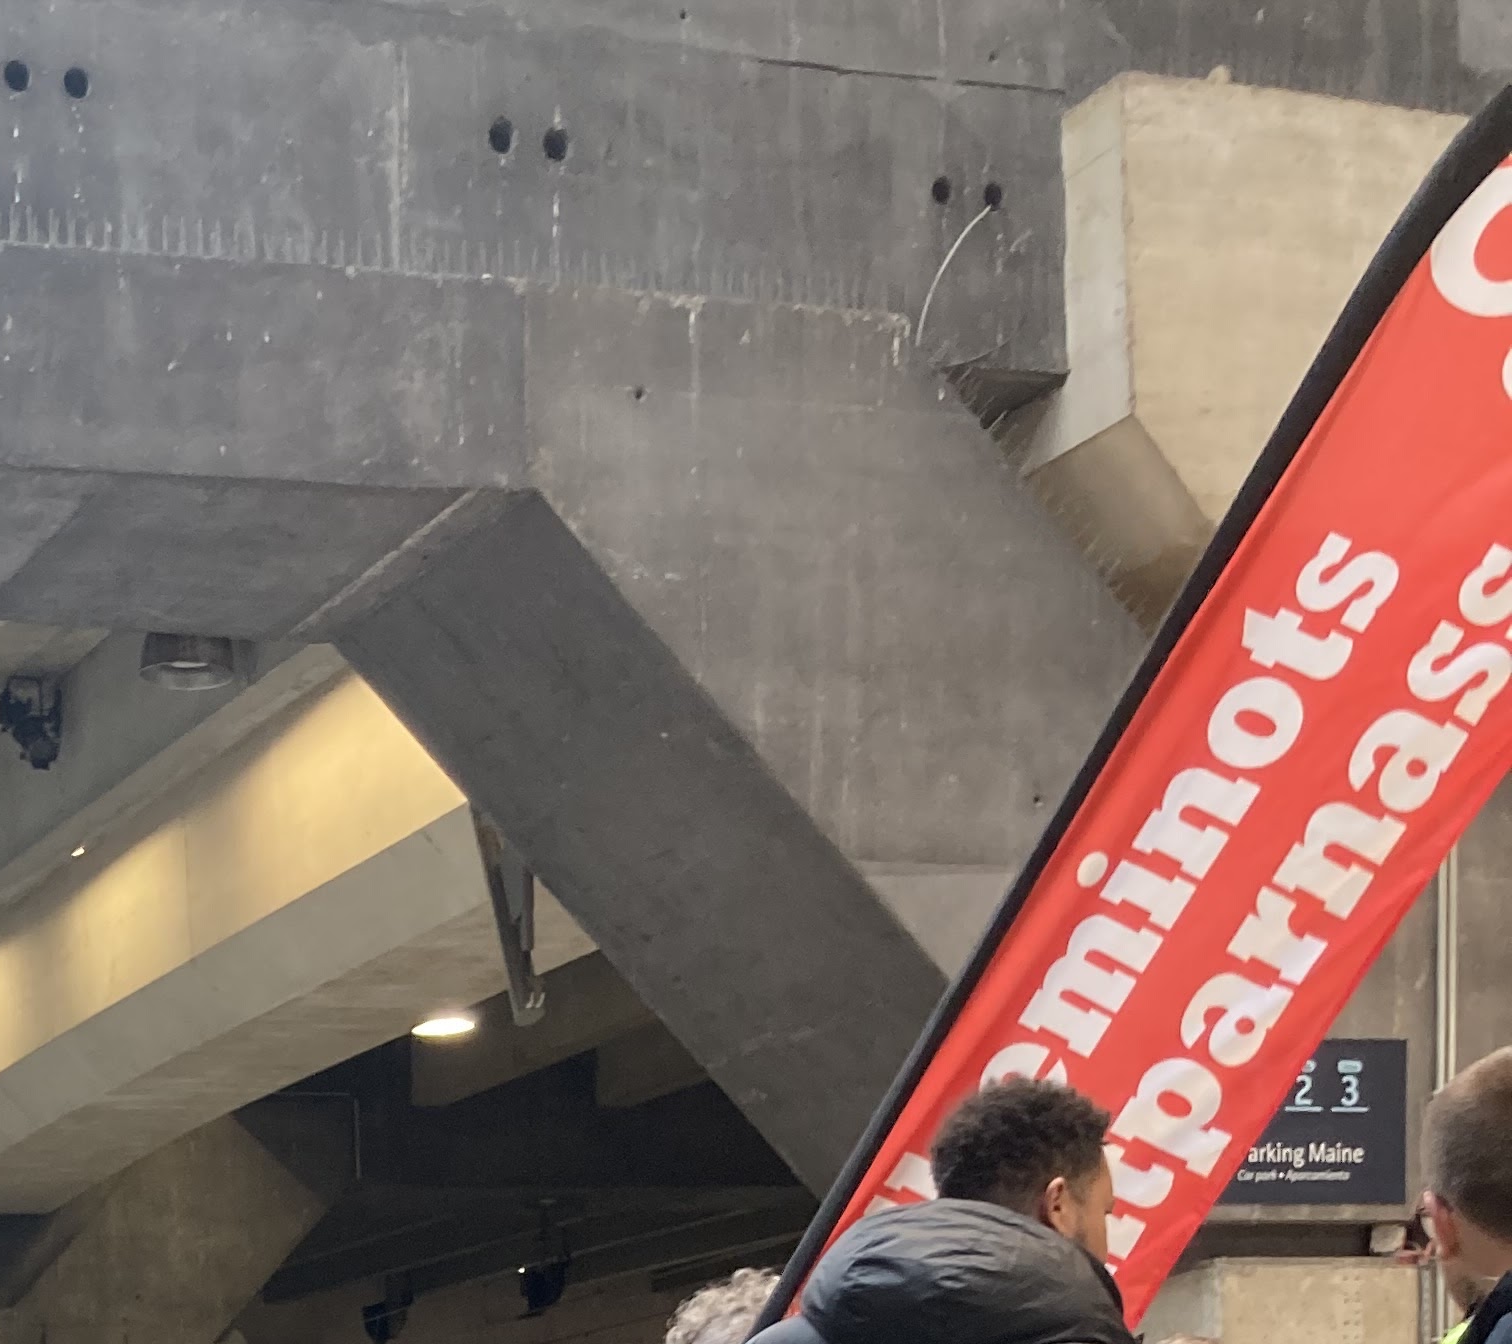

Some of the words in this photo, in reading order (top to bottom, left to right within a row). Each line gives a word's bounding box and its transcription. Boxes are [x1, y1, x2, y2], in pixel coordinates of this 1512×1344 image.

[863, 532, 1399, 1216] eminots
[1295, 1074, 1314, 1106] 2
[1341, 1074, 1360, 1107] 3
[1248, 1142, 1306, 1169] arking
[1308, 1142, 1366, 1164] Maine
